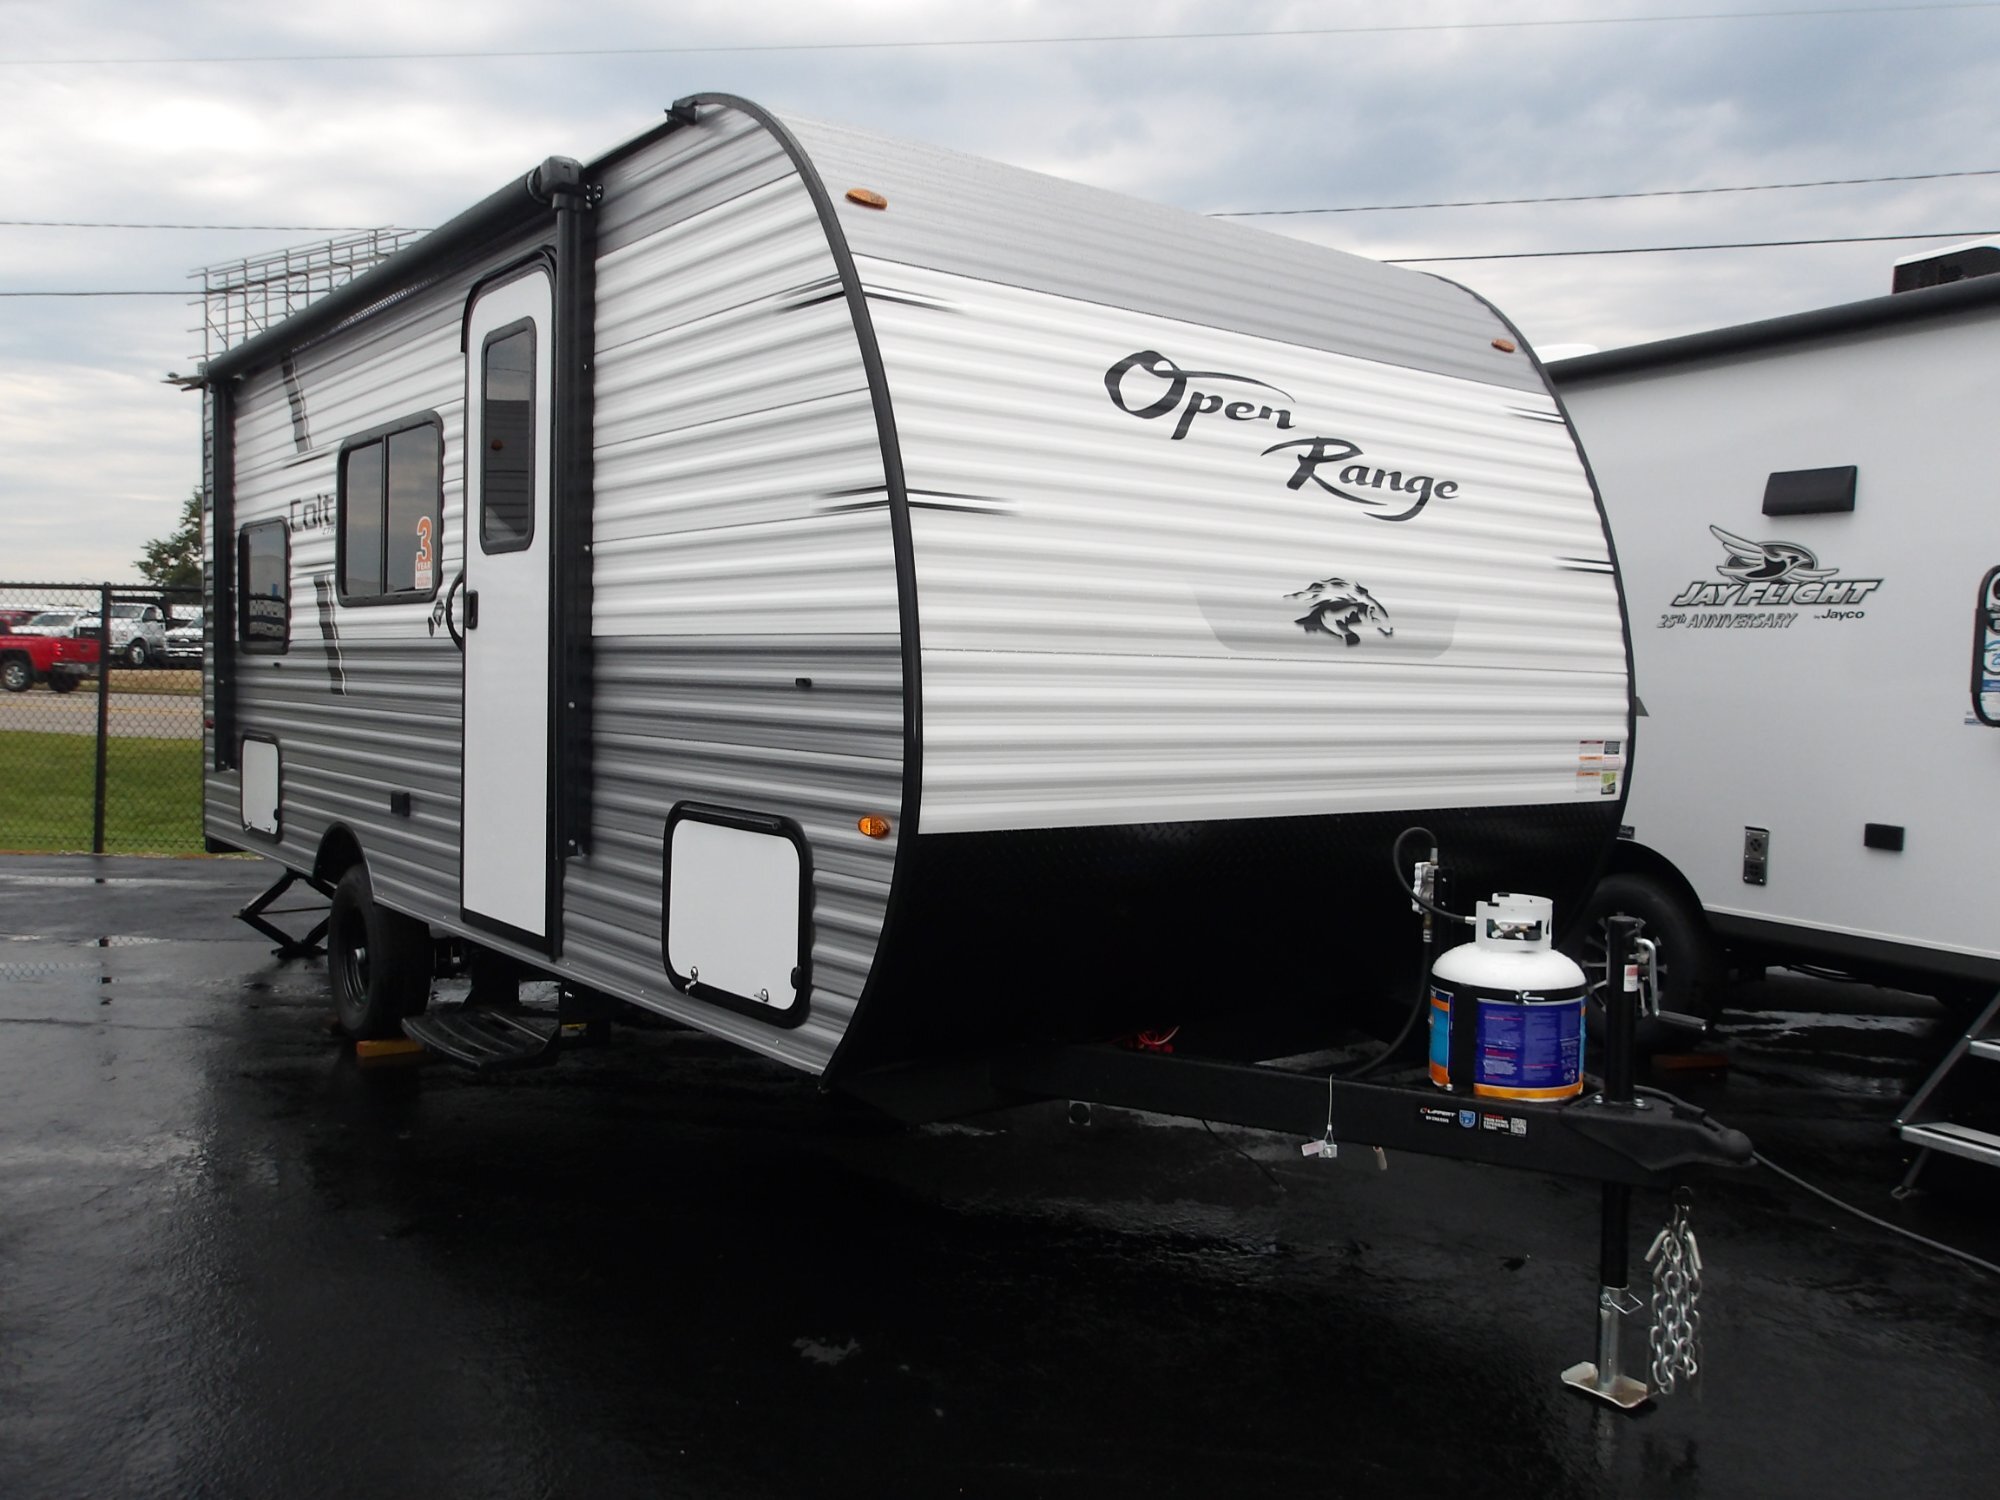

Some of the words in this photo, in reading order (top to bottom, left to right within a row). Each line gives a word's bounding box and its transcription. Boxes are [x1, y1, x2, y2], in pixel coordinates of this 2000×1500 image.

[1104, 350, 1296, 440] Open
[1261, 436, 1460, 521] Range
[290, 494, 335, 532] Colt
[417, 516, 432, 562] 3
[1687, 612, 1798, 629] ANNIVERSARY
[1821, 608, 1865, 621] Jayco
